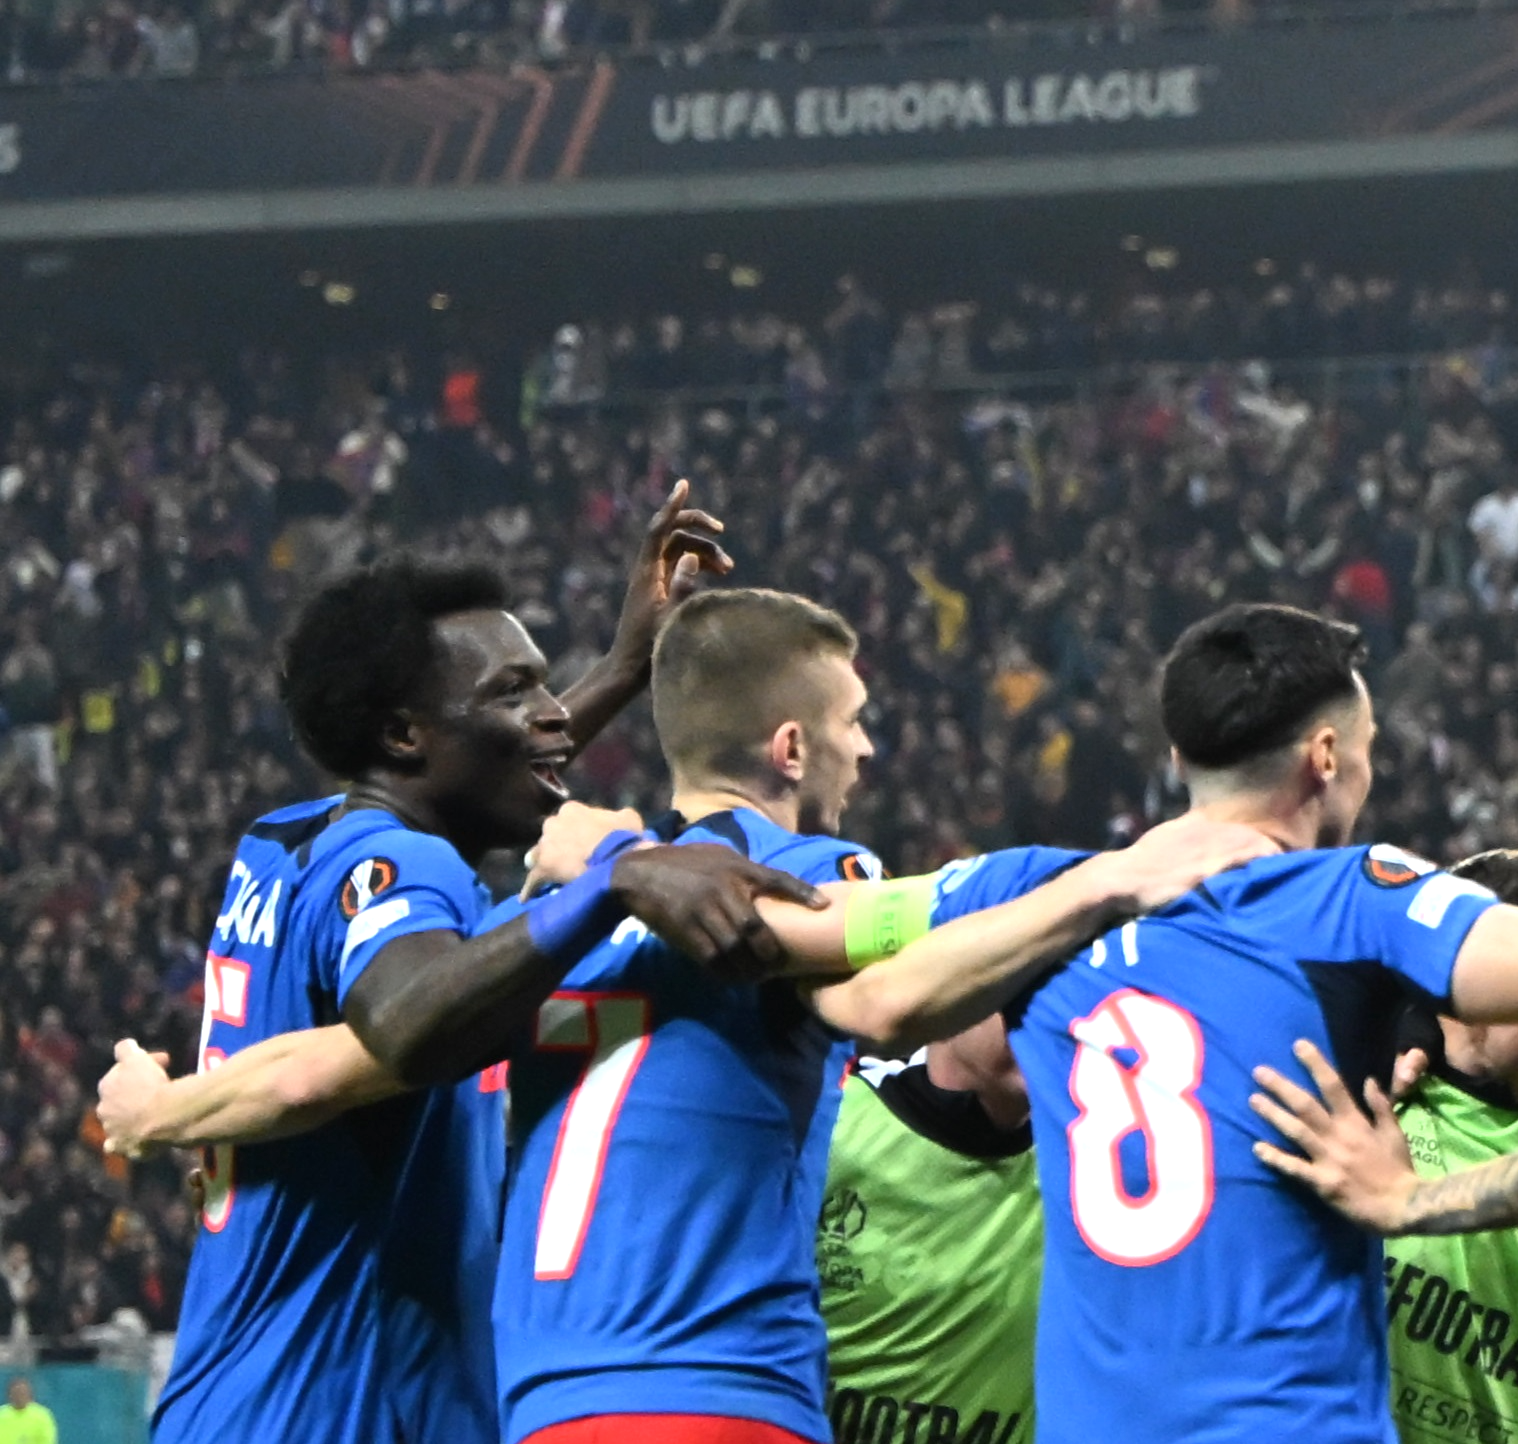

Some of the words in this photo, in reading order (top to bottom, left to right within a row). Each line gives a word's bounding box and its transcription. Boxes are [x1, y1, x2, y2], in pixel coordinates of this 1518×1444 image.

[651, 91, 783, 143] UEFA
[795, 80, 994, 138] EUROPA
[1004, 64, 1200, 126] LEAGUE
[533, 989, 652, 1281] 7
[1066, 987, 1216, 1267] 8
